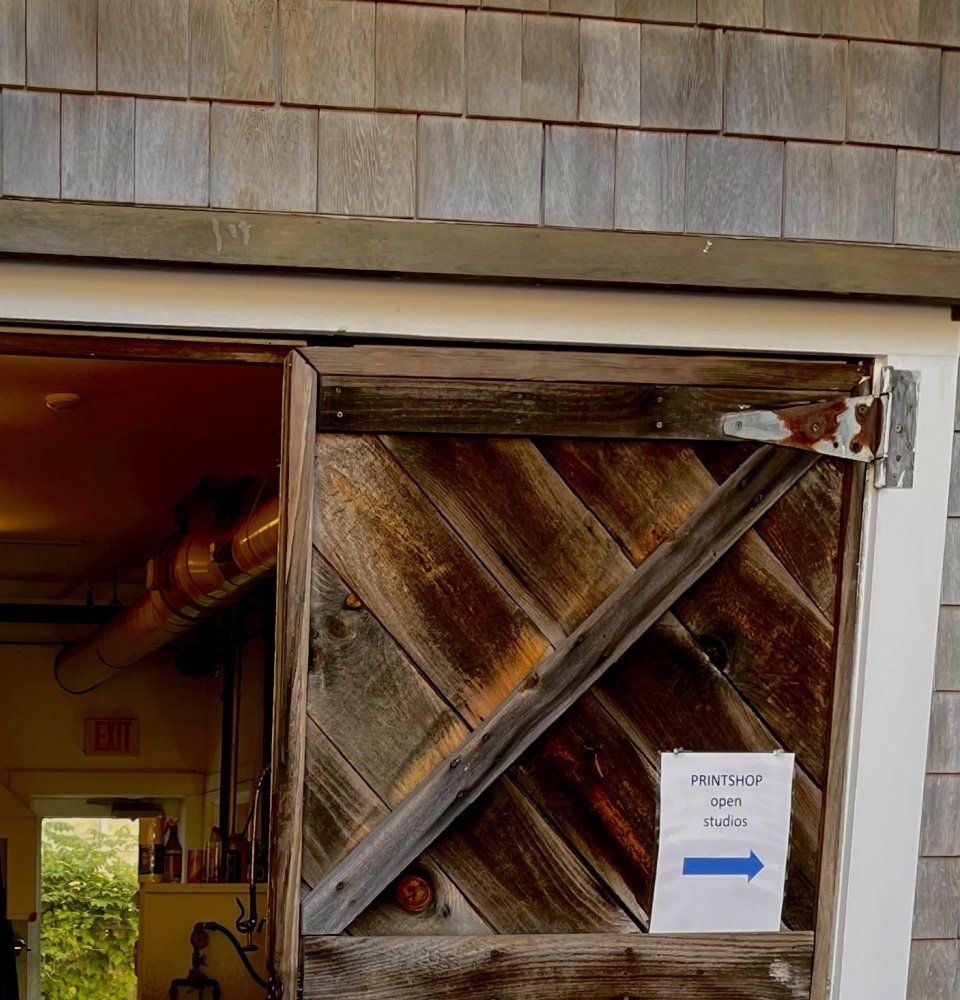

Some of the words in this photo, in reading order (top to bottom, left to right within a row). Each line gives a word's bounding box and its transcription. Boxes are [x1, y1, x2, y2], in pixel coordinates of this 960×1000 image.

[95, 720, 132, 752] EXIT
[691, 774, 763, 787] PRINTSHOP
[710, 796, 742, 810] open
[703, 815, 748, 828] studios
